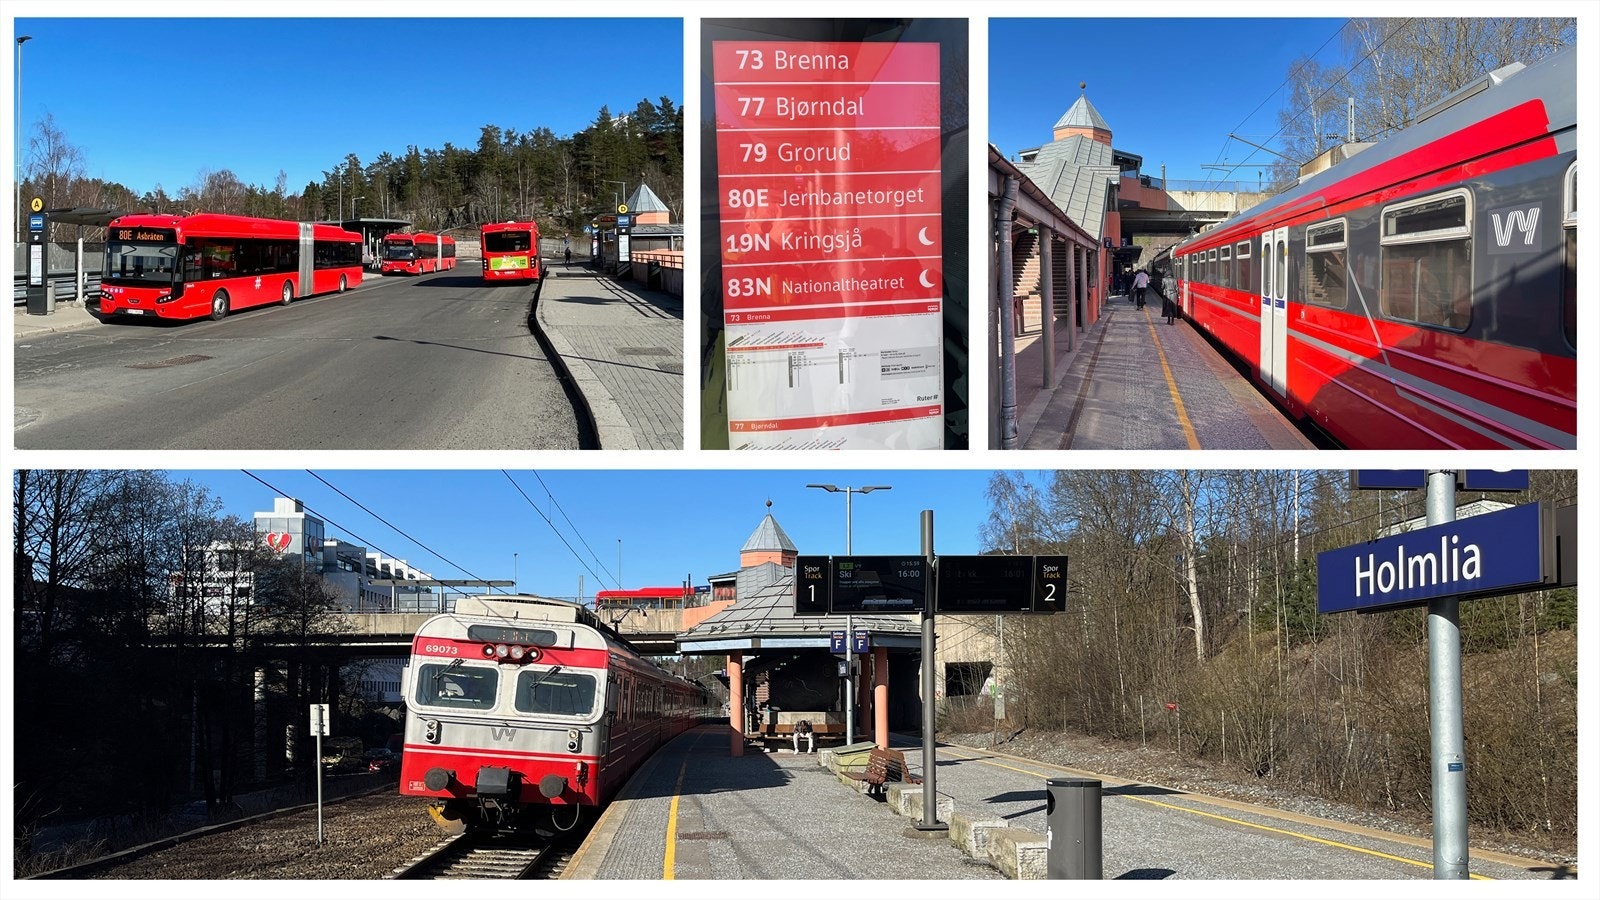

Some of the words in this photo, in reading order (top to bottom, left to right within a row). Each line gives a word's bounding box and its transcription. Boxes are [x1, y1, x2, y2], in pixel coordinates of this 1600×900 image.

[736, 50, 764, 70] 73
[775, 50, 850, 70] Brenna
[738, 98, 766, 116] 77
[776, 96, 864, 120] Bjørndal
[739, 144, 768, 162] 79
[778, 142, 851, 162] Grorud
[34, 200, 40, 208] A
[728, 189, 769, 208] 80E
[780, 187, 924, 208] Jernbanetorget
[119, 230, 132, 240] 80E
[1491, 207, 1541, 248] VY
[726, 234, 770, 253] 19N
[781, 228, 862, 253] Kringsjå
[727, 278, 772, 297] 83N
[782, 276, 905, 295] Nationaltheatret
[804, 565, 820, 574] Spor
[1043, 564, 1059, 573] Spor
[1355, 534, 1482, 598] Holmlia
[808, 585, 815, 602] 1
[1044, 584, 1056, 602] 2
[426, 644, 458, 654] 69073
[836, 640, 841, 649] F
[858, 640, 864, 649] F
